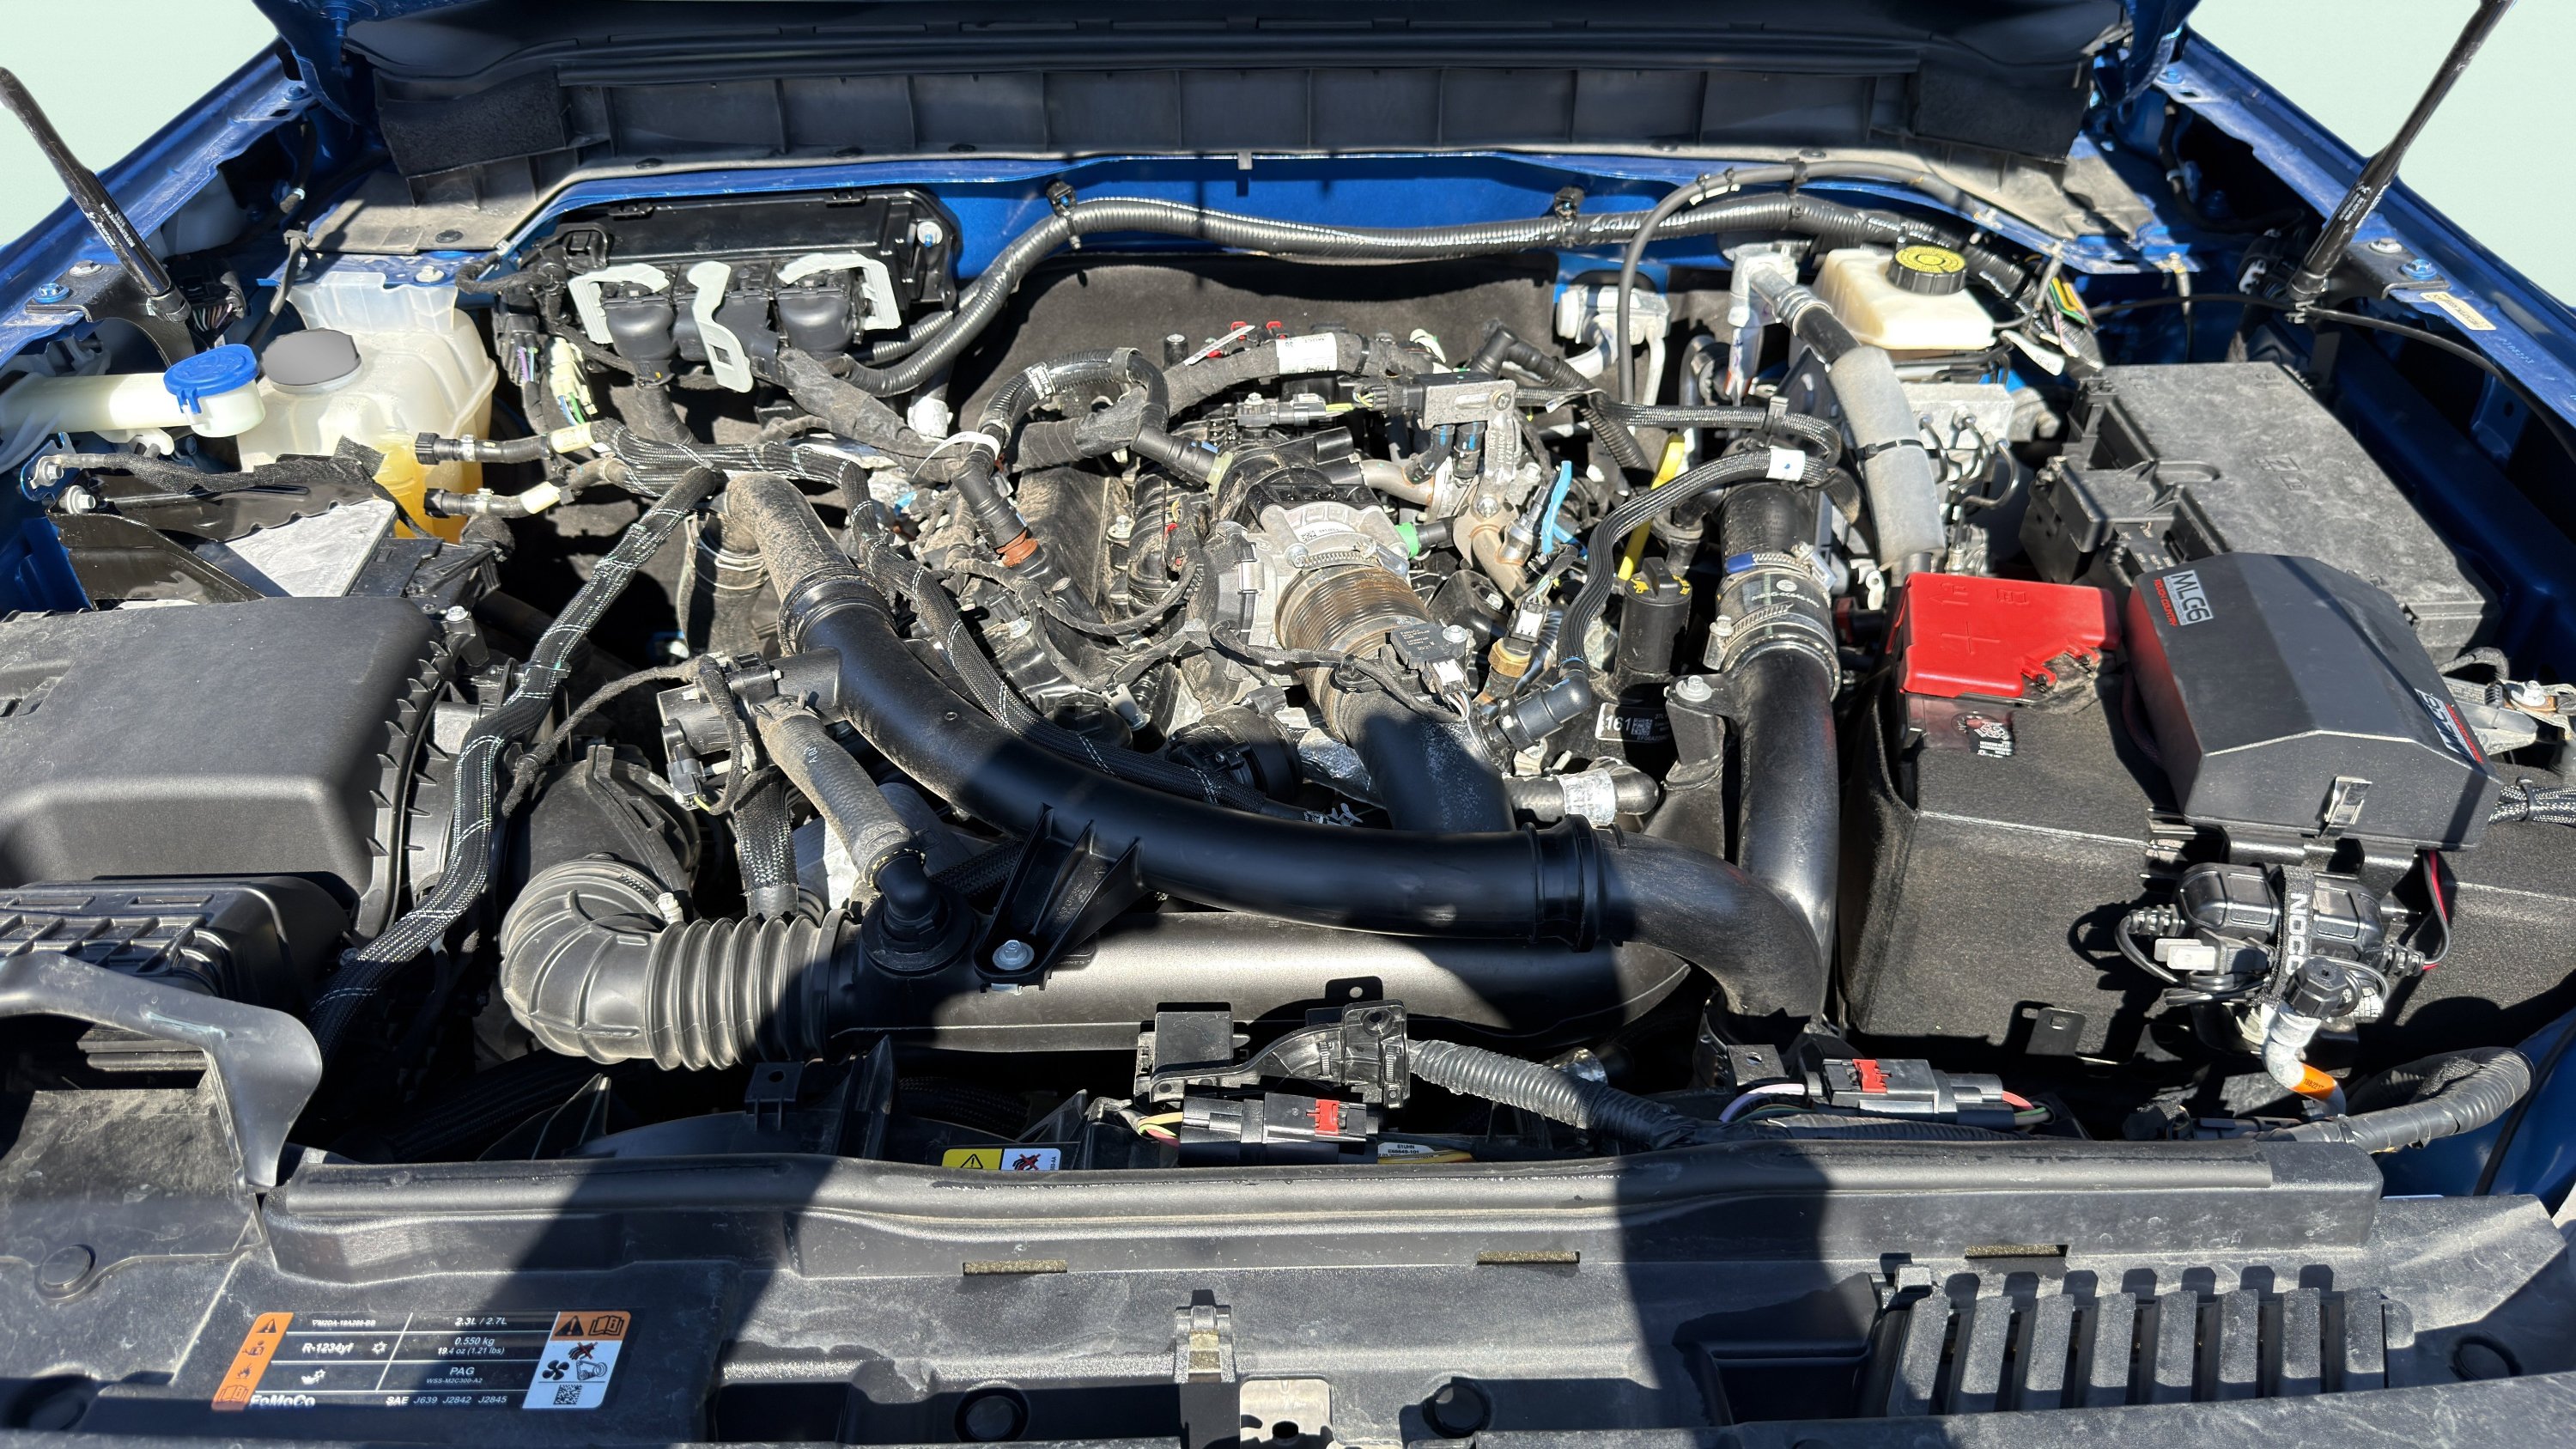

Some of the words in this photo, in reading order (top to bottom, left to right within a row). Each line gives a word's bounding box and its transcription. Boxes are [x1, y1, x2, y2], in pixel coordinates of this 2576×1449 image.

[1605, 715, 1631, 732] 161
[455, 1317, 477, 1327] 2.3L
[486, 1317, 507, 1325] 2.7L
[454, 1336, 481, 1346] 0.550
[483, 1336, 495, 1347] kg
[301, 1342, 355, 1355] R-1234yf
[438, 1347, 454, 1355] 19.4
[467, 1347, 487, 1355] (1.21
[489, 1347, 505, 1355] lbs)
[449, 1367, 475, 1376] PAG
[249, 1393, 316, 1407] FoMoCo
[386, 1396, 410, 1406] SAE
[413, 1396, 438, 1404] J639
[442, 1396, 472, 1404] J2842
[478, 1396, 507, 1404] J2845
